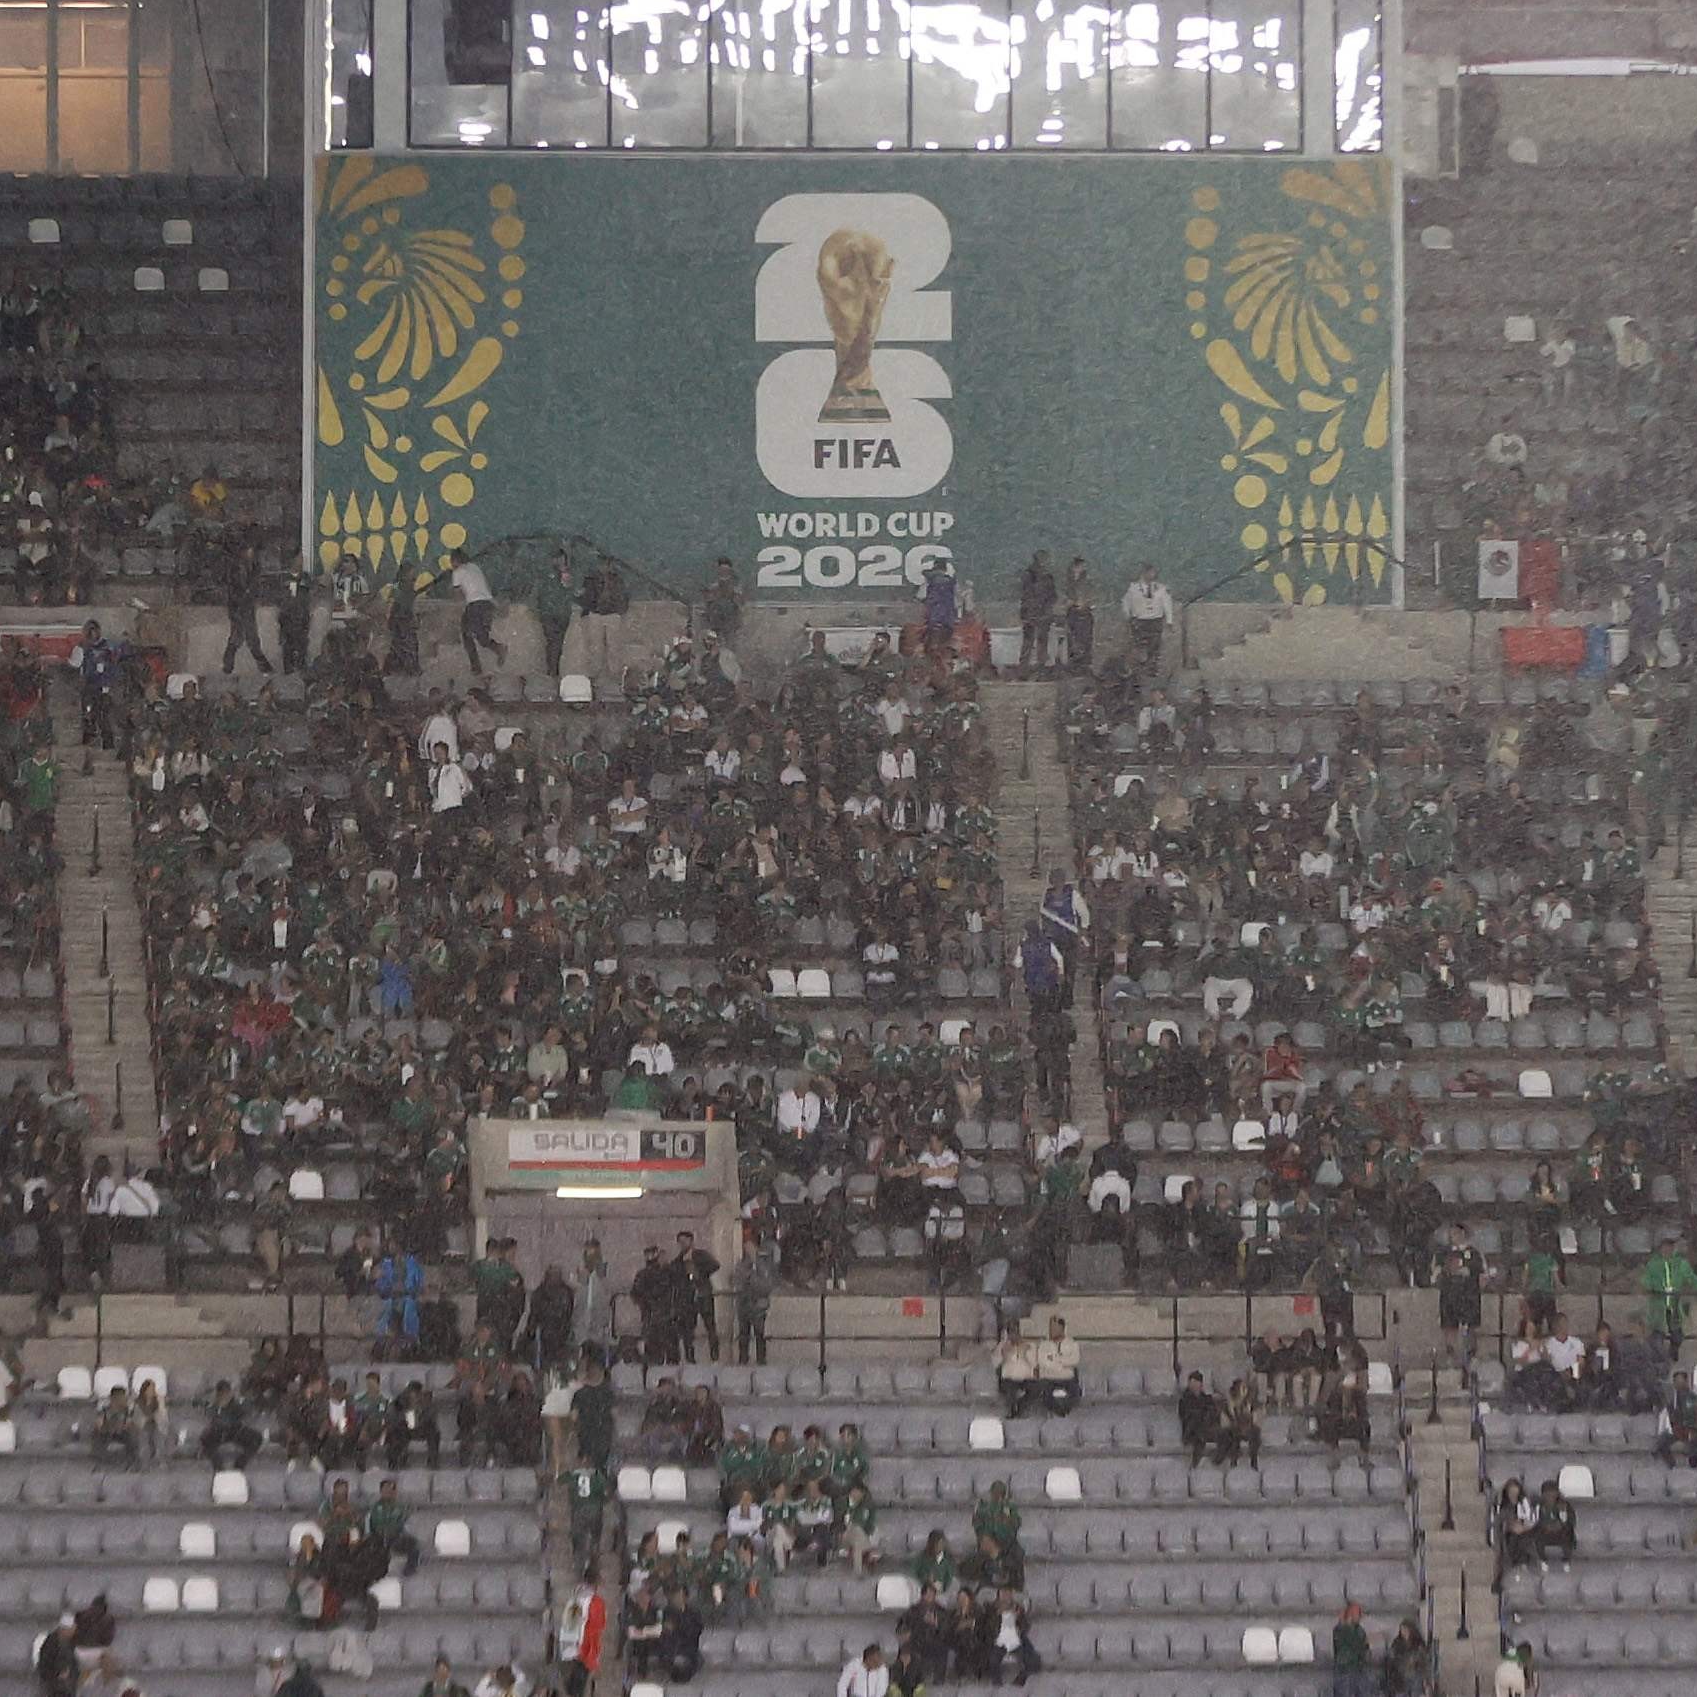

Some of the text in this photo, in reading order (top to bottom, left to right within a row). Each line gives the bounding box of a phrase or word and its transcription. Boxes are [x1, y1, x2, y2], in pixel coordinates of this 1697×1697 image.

[814, 438, 901, 469] FIFA
[756, 512, 955, 538] WORLD CUP
[534, 1132, 629, 1151] SALIDA
[652, 1132, 696, 1159] 40
